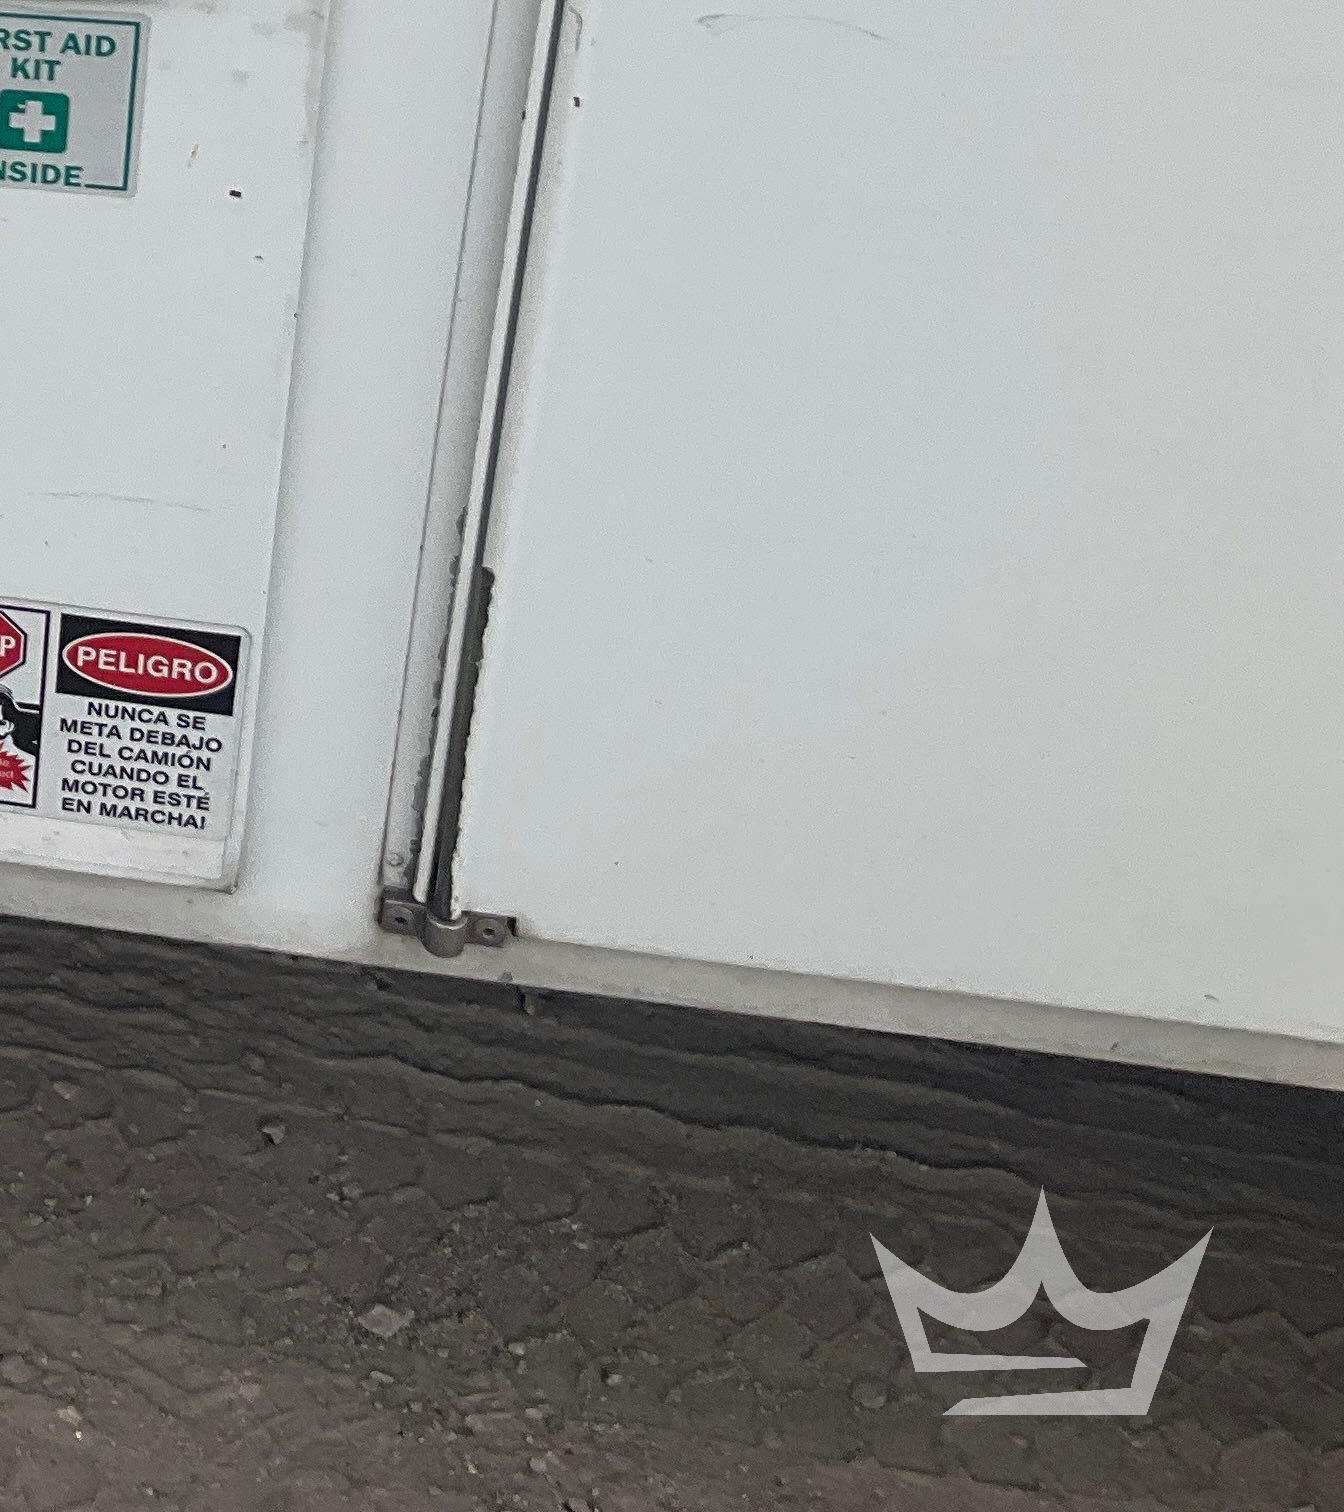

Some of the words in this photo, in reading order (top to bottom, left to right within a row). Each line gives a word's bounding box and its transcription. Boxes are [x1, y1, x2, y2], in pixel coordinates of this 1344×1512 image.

[60, 32, 117, 57] AID
[10, 56, 61, 81] KIT
[77, 645, 219, 685] PELIGRO
[88, 701, 169, 727] NUNCA
[176, 713, 206, 731] SE
[59, 718, 122, 740] META
[129, 727, 223, 753] DEBAJO
[67, 739, 111, 758] DEL
[118, 746, 212, 771] CAMIÓN
[71, 760, 170, 785] CUANDO
[177, 773, 205, 791] EL
[61, 778, 146, 802] MOTOR
[153, 791, 210, 811] ESTÉ
[62, 797, 91, 814] EN
[99, 802, 206, 830] MARCHA!
